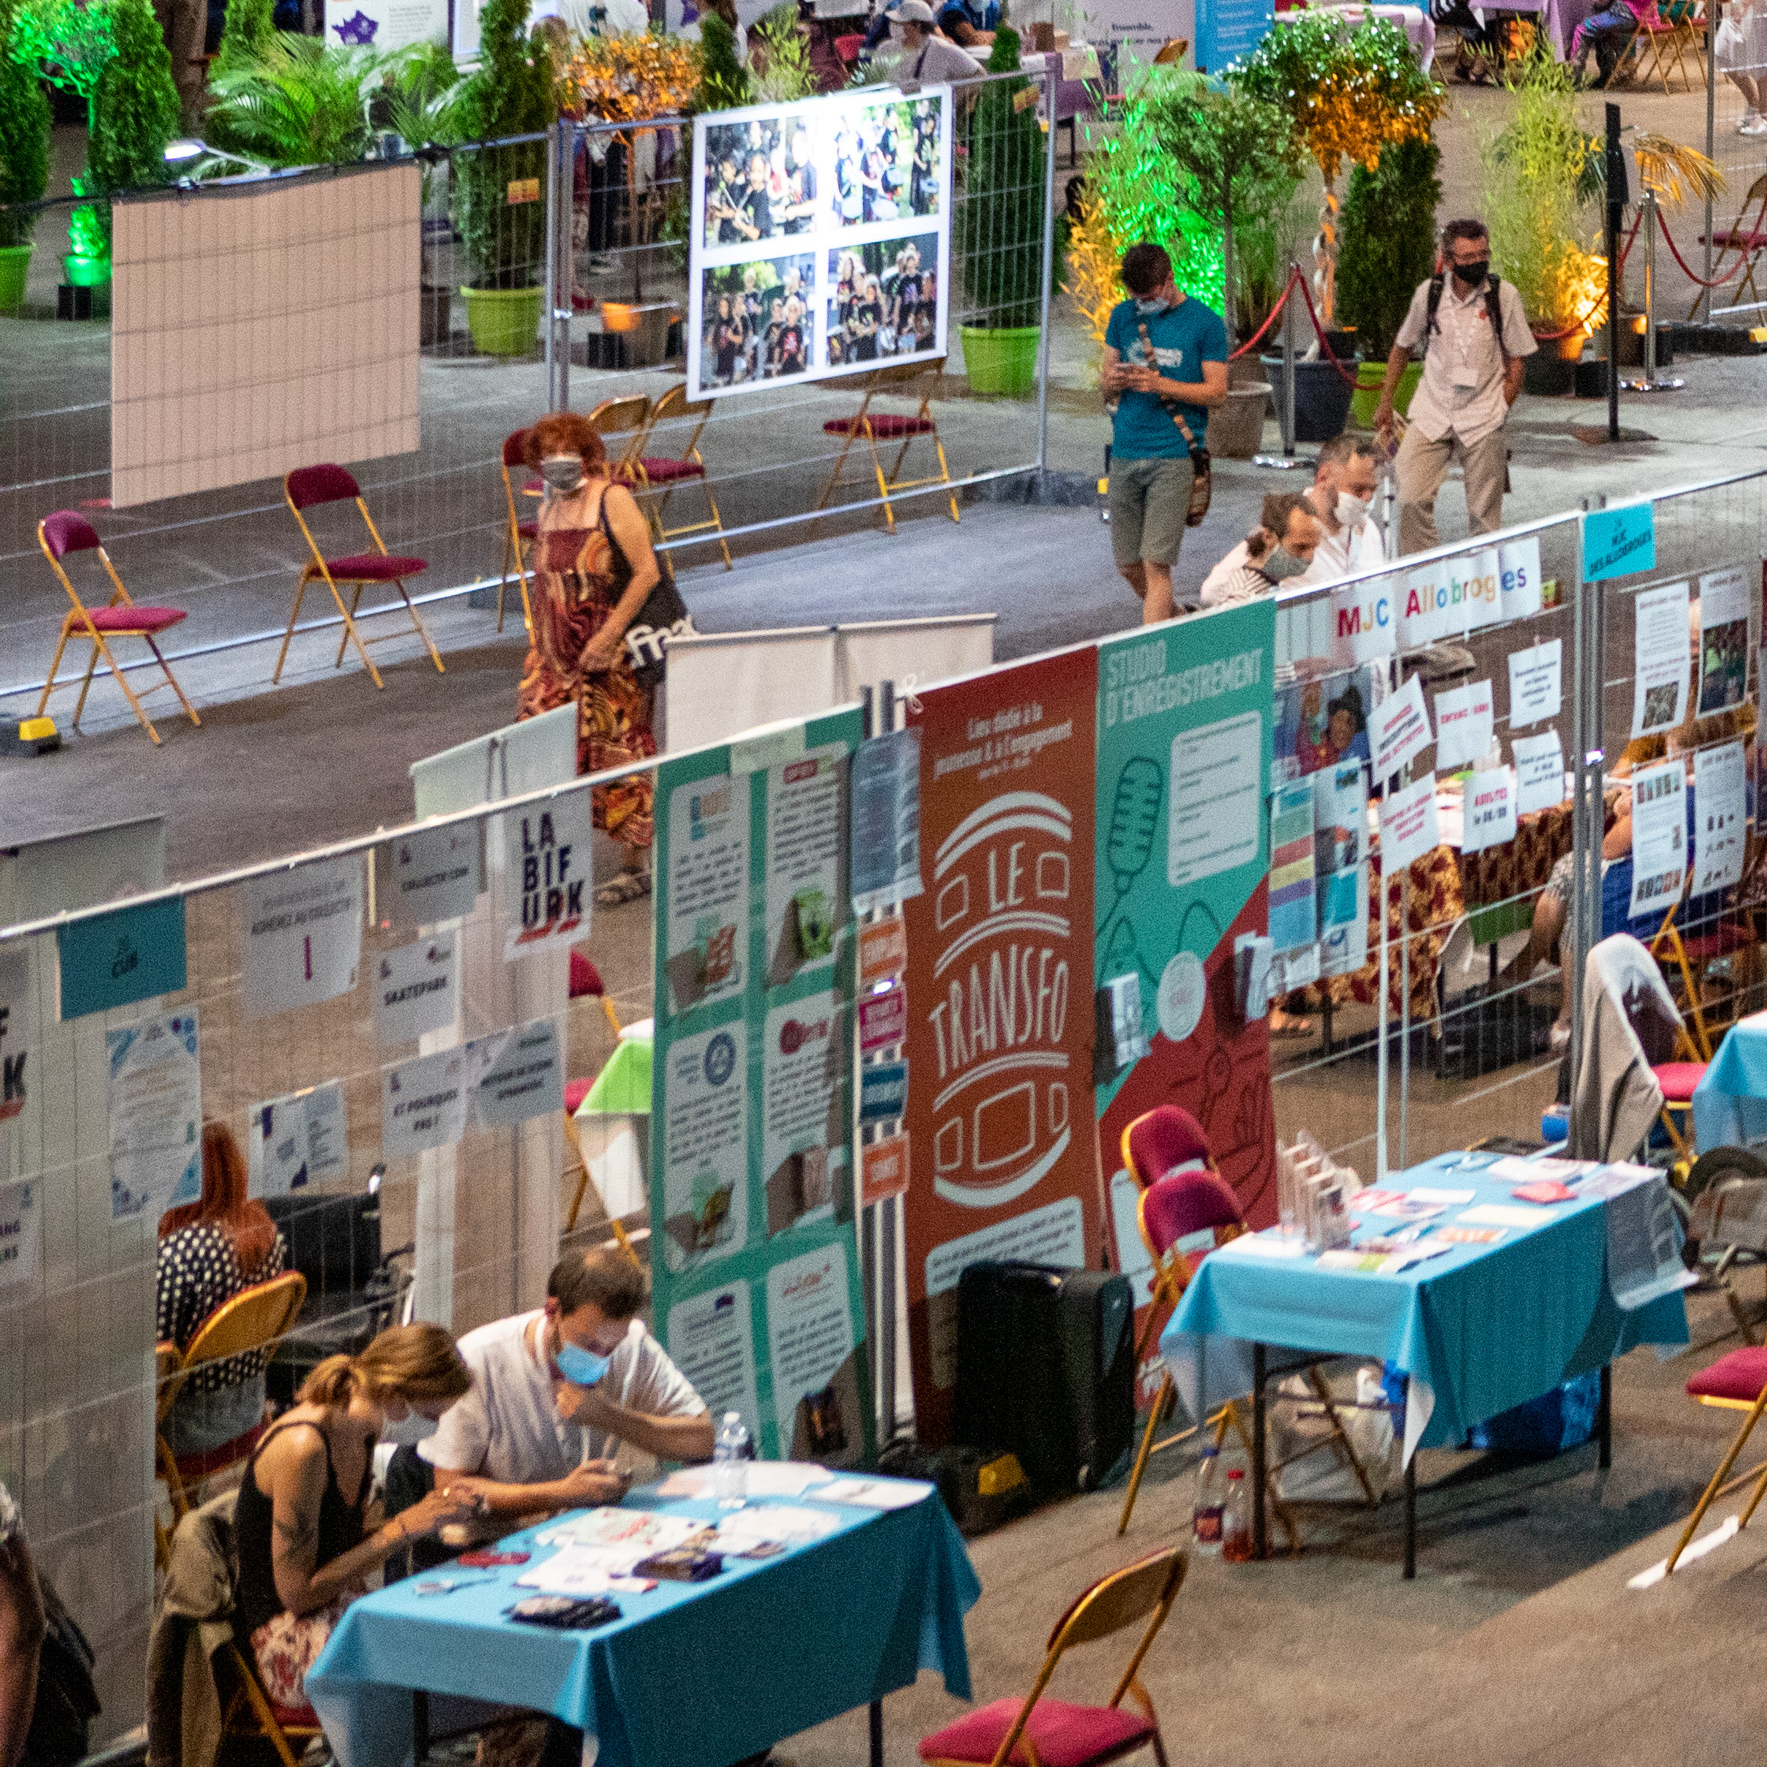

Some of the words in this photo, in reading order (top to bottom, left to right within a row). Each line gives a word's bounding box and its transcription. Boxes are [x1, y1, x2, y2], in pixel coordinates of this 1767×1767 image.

[1337, 597, 1390, 637] MJC
[1404, 565, 1527, 620] Allobroges
[1105, 648, 1264, 728] D'ENREGISTREMENT
[1107, 639, 1167, 687] STUDIO
[521, 811, 555, 855] LA
[522, 844, 572, 894] BIF
[988, 841, 1025, 914] LE
[520, 879, 585, 929] URK
[384, 976, 448, 1007] SKATEPARK
[927, 942, 1070, 1079] TRANSFO
